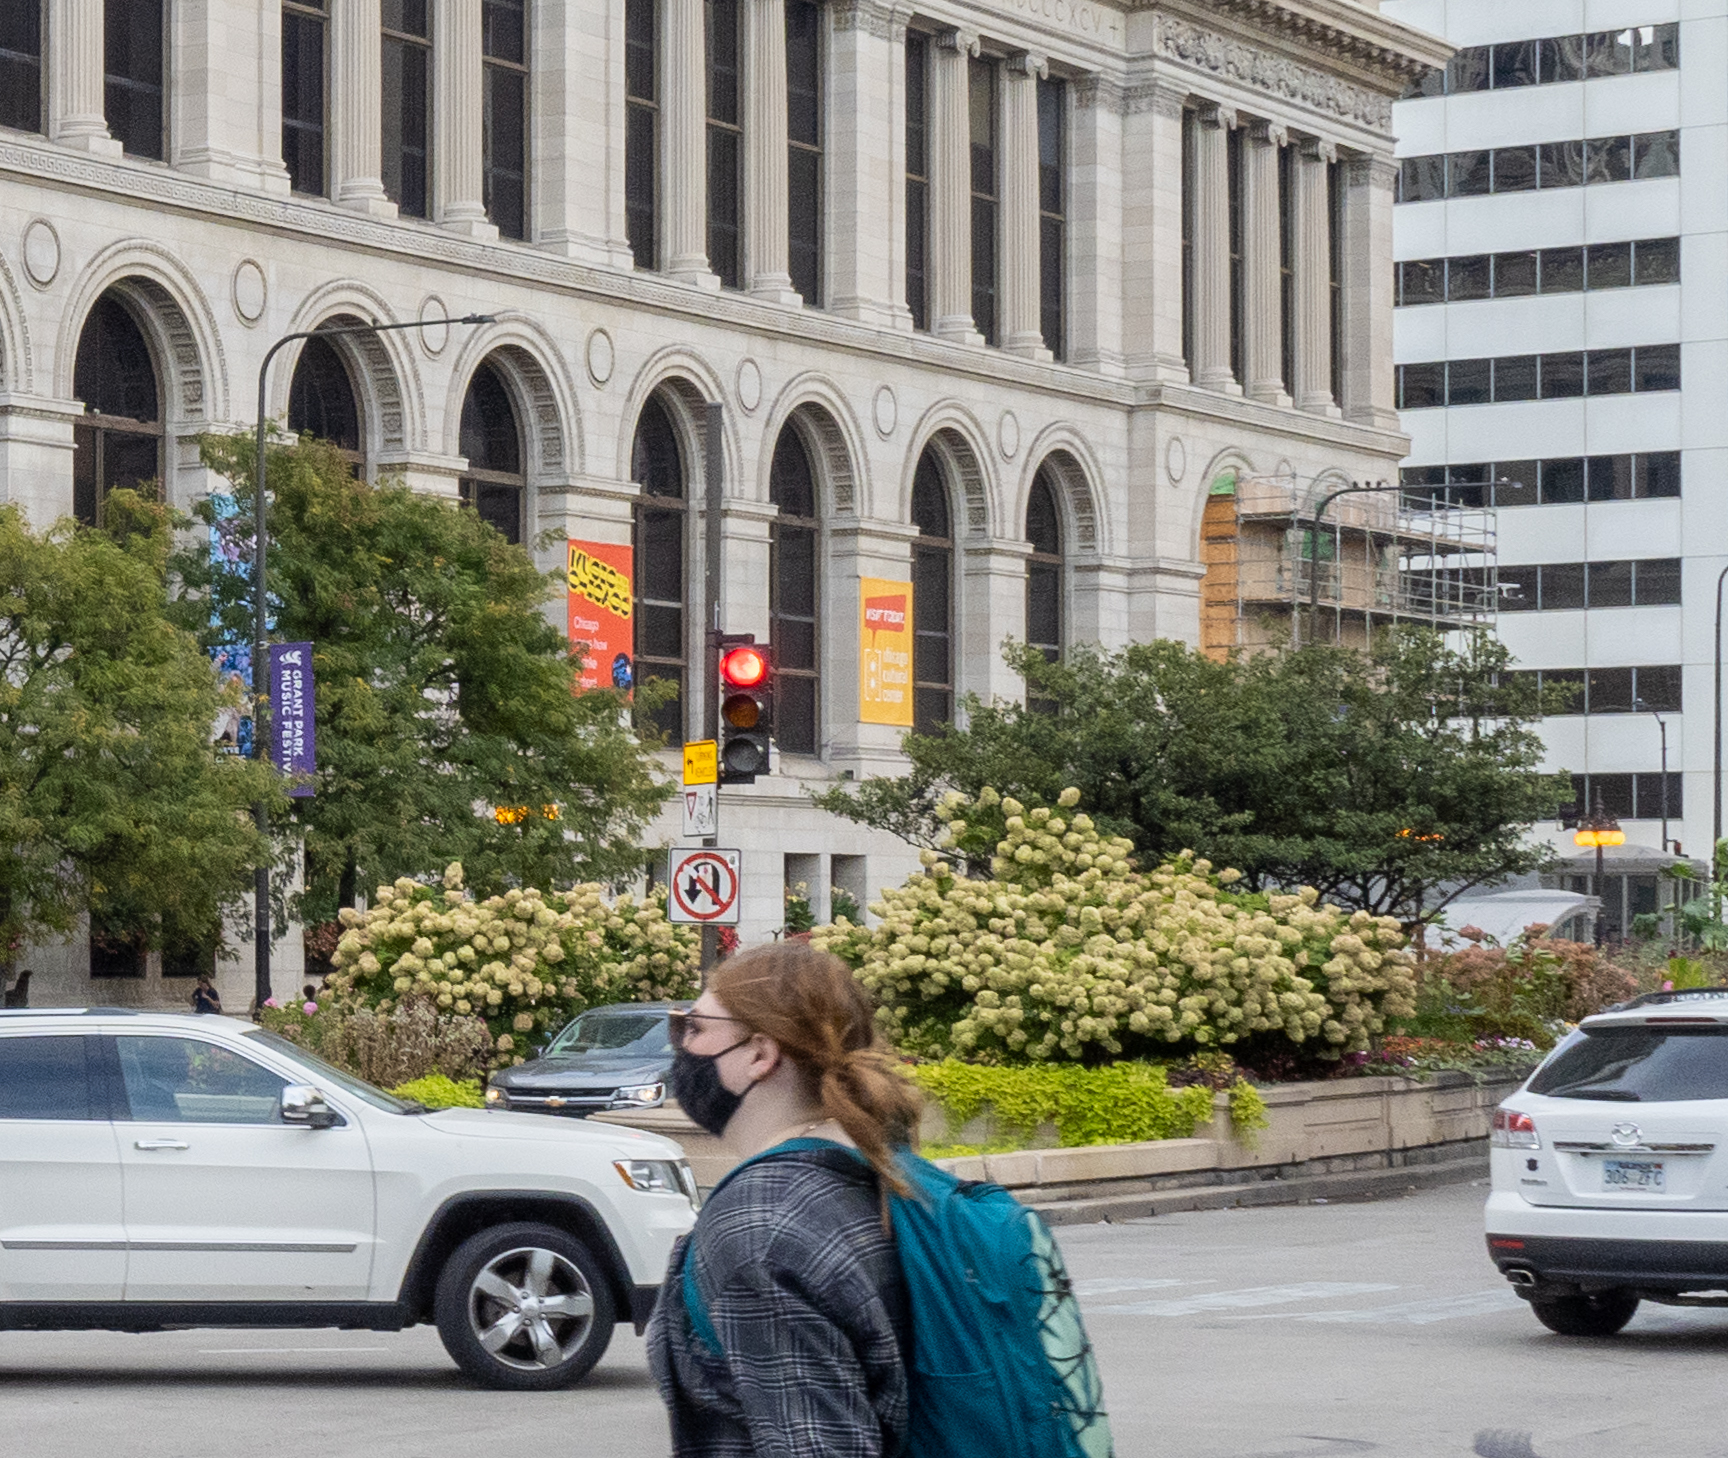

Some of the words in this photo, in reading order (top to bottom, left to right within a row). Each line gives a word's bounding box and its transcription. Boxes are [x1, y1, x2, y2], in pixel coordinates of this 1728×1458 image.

[281, 669, 292, 716] MUSIC
[292, 669, 304, 717] GRANT
[281, 721, 293, 778] FESTIVA
[292, 720, 304, 757] PARK
